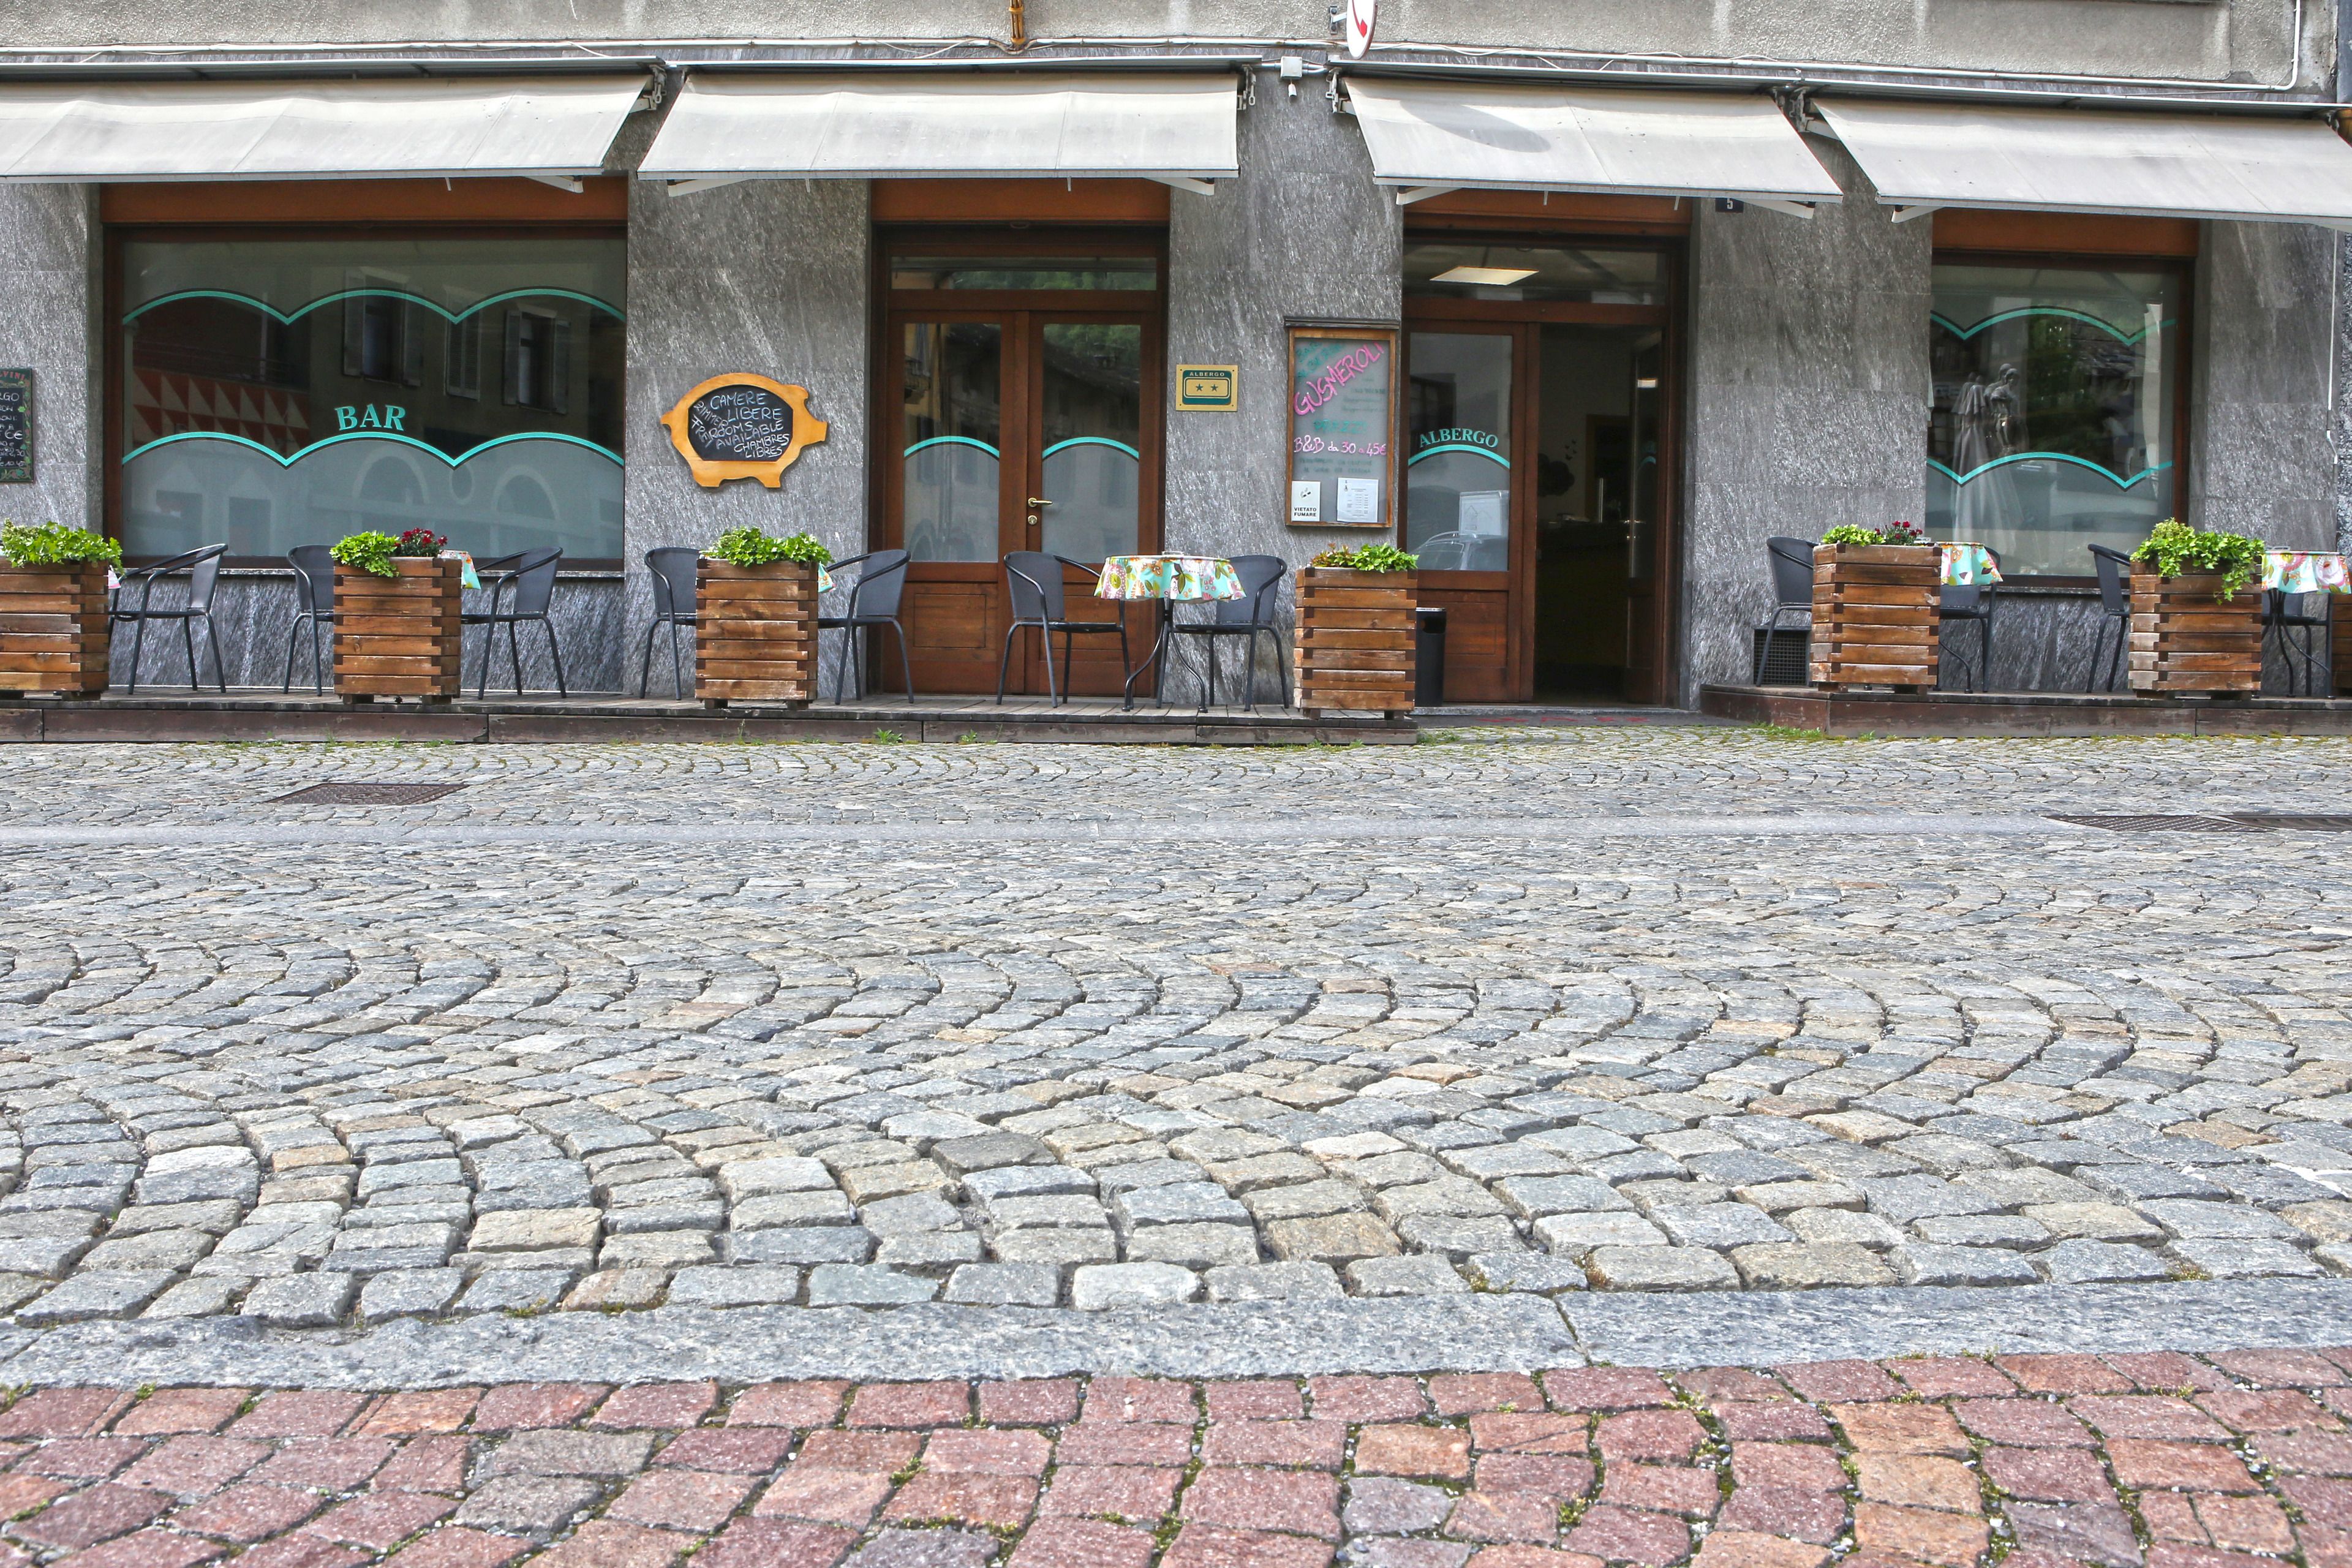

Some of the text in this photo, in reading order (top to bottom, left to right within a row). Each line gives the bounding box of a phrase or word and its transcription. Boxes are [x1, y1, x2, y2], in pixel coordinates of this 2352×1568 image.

[1727, 197, 1733, 209] 5
[0, 371, 25, 380] VINI
[1294, 342, 1385, 416] GUSMEROLI
[710, 390, 767, 410] CAMERE
[334, 403, 405, 431] BAR
[693, 400, 729, 430] ZIMMER
[727, 407, 783, 423] LIBERE
[708, 421, 755, 439] ROOMS
[715, 419, 785, 450] AVAILABLE
[1419, 428, 1499, 448] ALBERGO
[734, 433, 790, 453] CHAMBRES
[745, 446, 783, 458] LIBRES
[1294, 434, 1325, 454] B&B
[1327, 441, 1339, 451] da
[1341, 441, 1357, 454] 30
[1366, 443, 1387, 457] 45€
